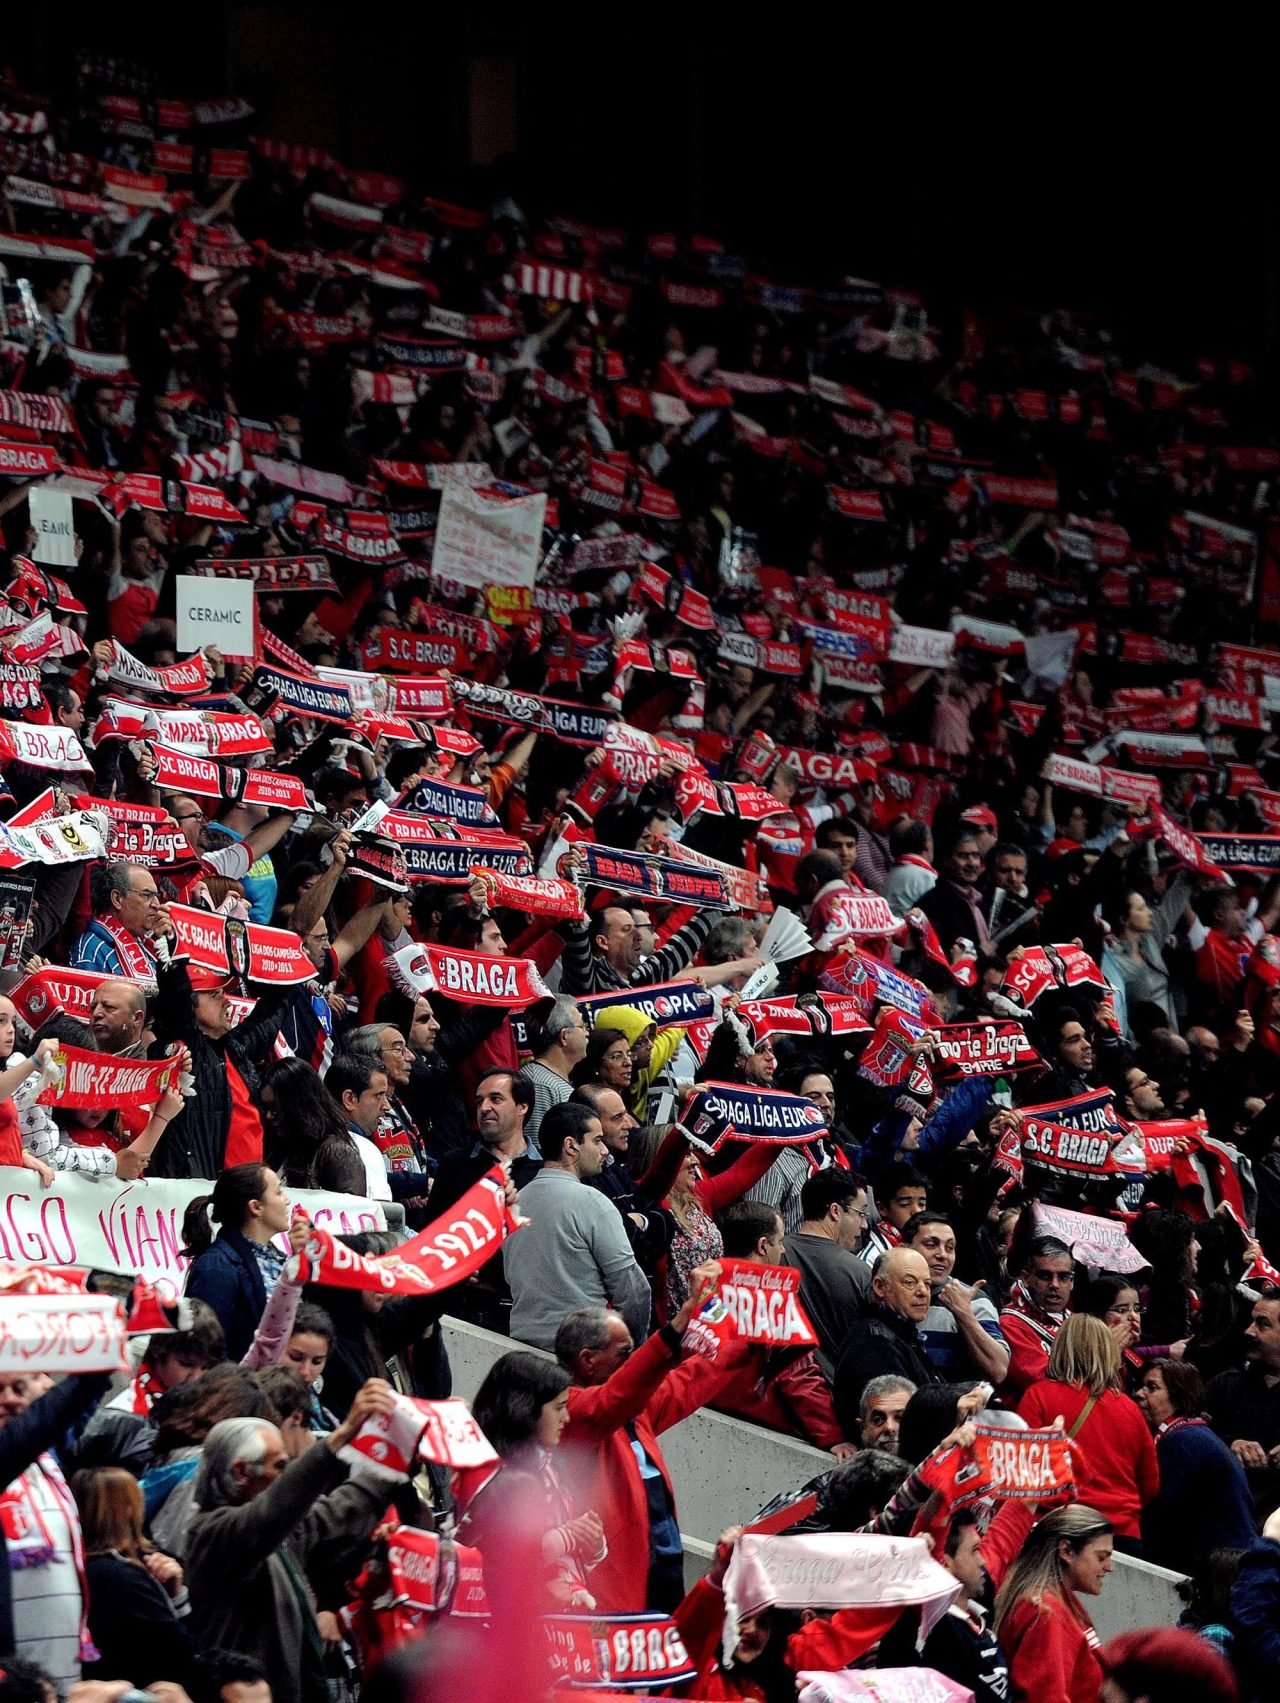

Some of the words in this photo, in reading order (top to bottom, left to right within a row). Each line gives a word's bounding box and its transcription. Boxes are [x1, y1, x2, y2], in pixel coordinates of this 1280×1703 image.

[0, 449, 46, 470] BRAGA
[188, 607, 242, 625] CERAMIC
[416, 641, 457, 665] BRAGA
[161, 758, 178, 777] SC
[179, 760, 218, 781] BRAGA
[249, 772, 263, 785] LIGA
[413, 851, 455, 871] BRAGA
[176, 920, 193, 942] SC
[194, 924, 223, 952] BRAGA
[251, 943, 264, 955] LIGA
[447, 954, 519, 998] BRAGA
[753, 1096, 781, 1128] LIGA
[1024, 1122, 1054, 1155] S.C.
[1056, 1132, 1109, 1166] BRAGA
[420, 1208, 498, 1270] 1921
[720, 1284, 812, 1342] BRAGA
[989, 1439, 1057, 1488] BRAGA
